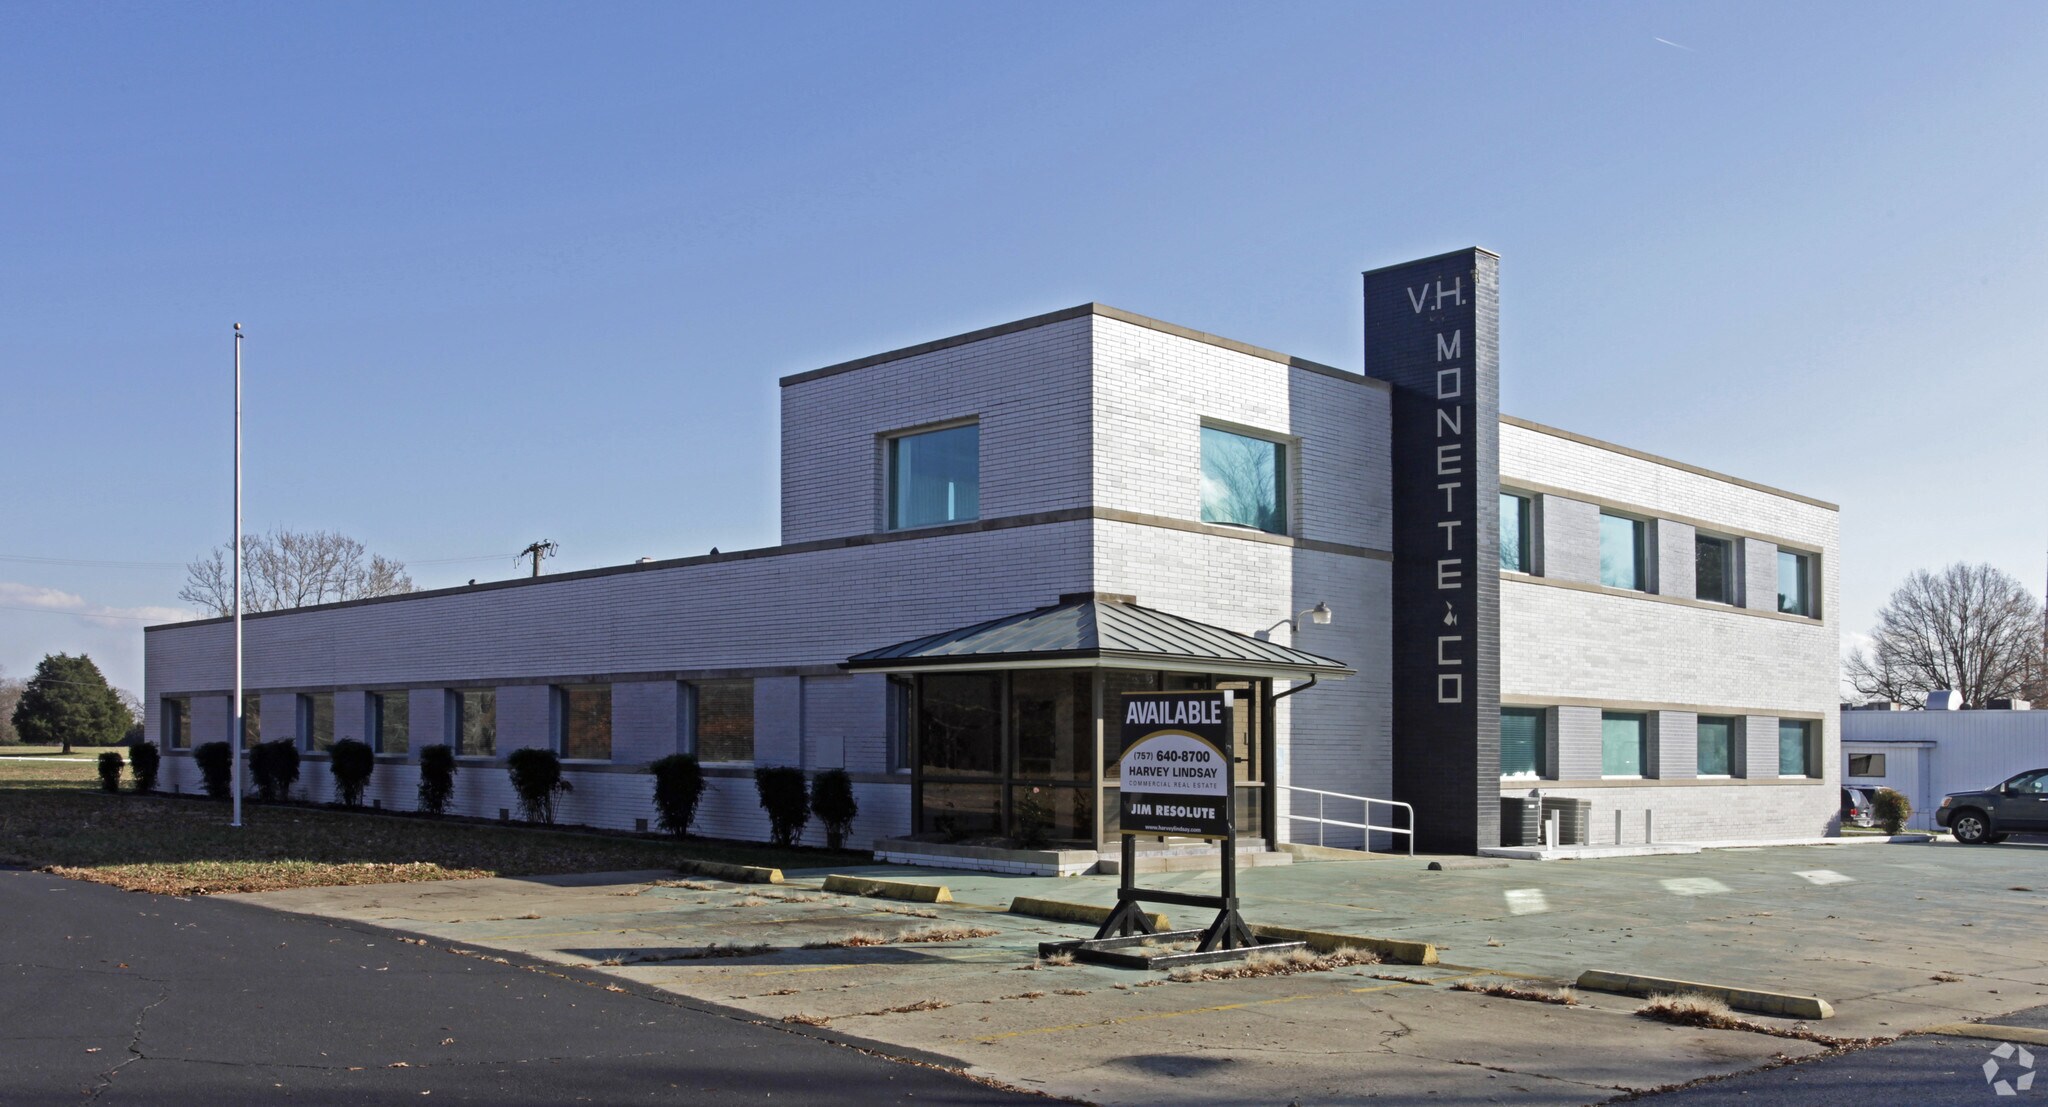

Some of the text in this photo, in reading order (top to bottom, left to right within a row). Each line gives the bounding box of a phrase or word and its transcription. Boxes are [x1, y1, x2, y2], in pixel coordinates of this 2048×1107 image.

[1407, 276, 1467, 314] V.H.
[1437, 329, 1462, 590] MONETTE
[1437, 635, 1462, 703] CO
[1126, 700, 1222, 725] AVAILABLE
[1133, 750, 1211, 763] (757) 640-8700
[1129, 766, 1218, 779] HARVEY LINDSAY
[1128, 780, 1171, 788] COMMERCIAL
[1193, 782, 1217, 790] ESTATE
[1131, 803, 1216, 820] JIM RESOLUTE
[1144, 823, 1202, 834] www.harveylindsay.com
